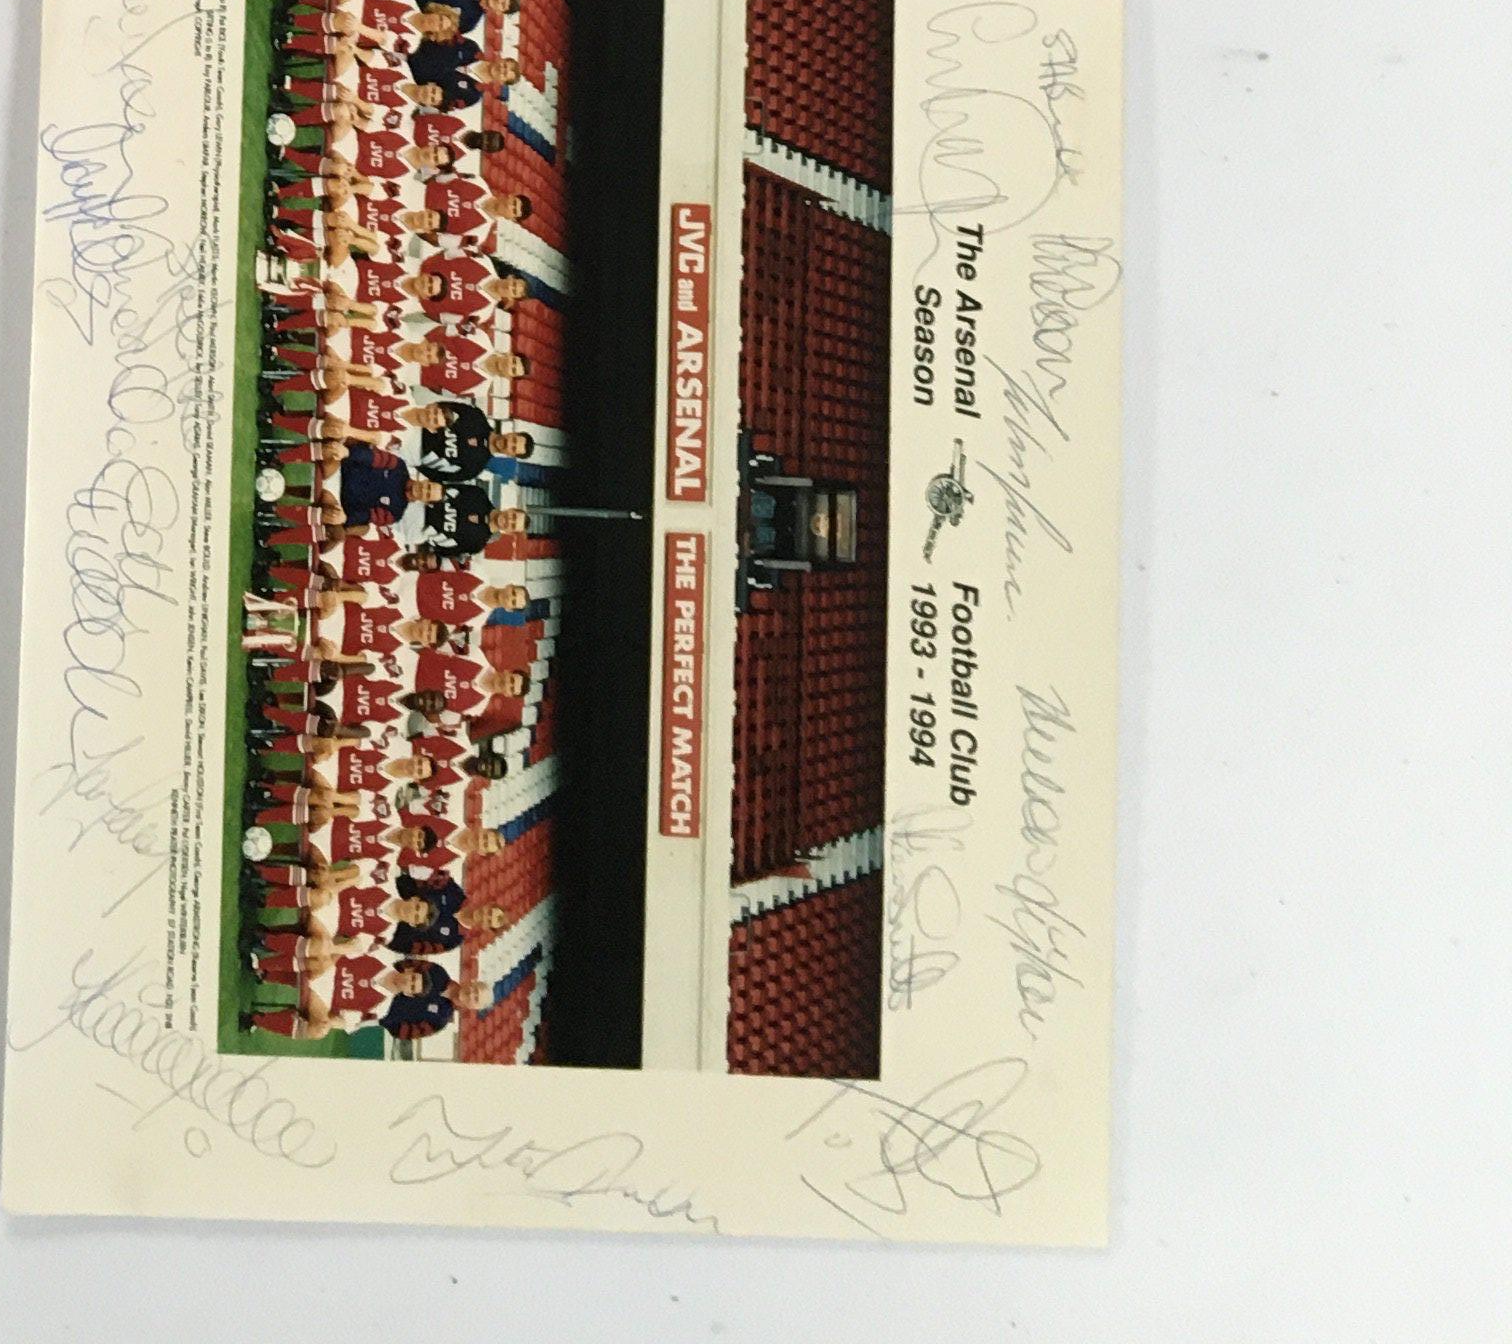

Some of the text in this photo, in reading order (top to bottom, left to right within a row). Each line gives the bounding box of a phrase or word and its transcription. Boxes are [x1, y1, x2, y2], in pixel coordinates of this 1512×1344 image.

[374, 8, 387, 31] JVC
[367, 73, 379, 102] JVC
[370, 141, 383, 168] JVC
[366, 202, 378, 231] JVC
[447, 189, 460, 218] JVC
[368, 269, 381, 296] JVC
[450, 271, 462, 300] JVC
[954, 223, 983, 418] The Arsenal
[363, 335, 375, 364] JVC
[673, 208, 705, 496] JVC and ARSENAL
[912, 285, 941, 407] Season
[445, 350, 458, 379] JVC
[366, 399, 380, 429] JVC
[444, 428, 458, 458] JVC
[443, 502, 457, 532] JVC
[357, 546, 371, 576] JVC
[442, 581, 455, 611] JVC
[360, 612, 373, 644] JVC
[910, 582, 937, 658] 1993
[444, 670, 457, 699] JVC
[669, 537, 697, 835] THE PERFECT MATCH
[949, 582, 979, 806] Football Club
[357, 685, 370, 716] JVC
[908, 692, 935, 767] 1994
[349, 754, 362, 784] JVC
[349, 824, 362, 853] JVC
[351, 897, 364, 928] JVC
[341, 967, 354, 999] JVC
